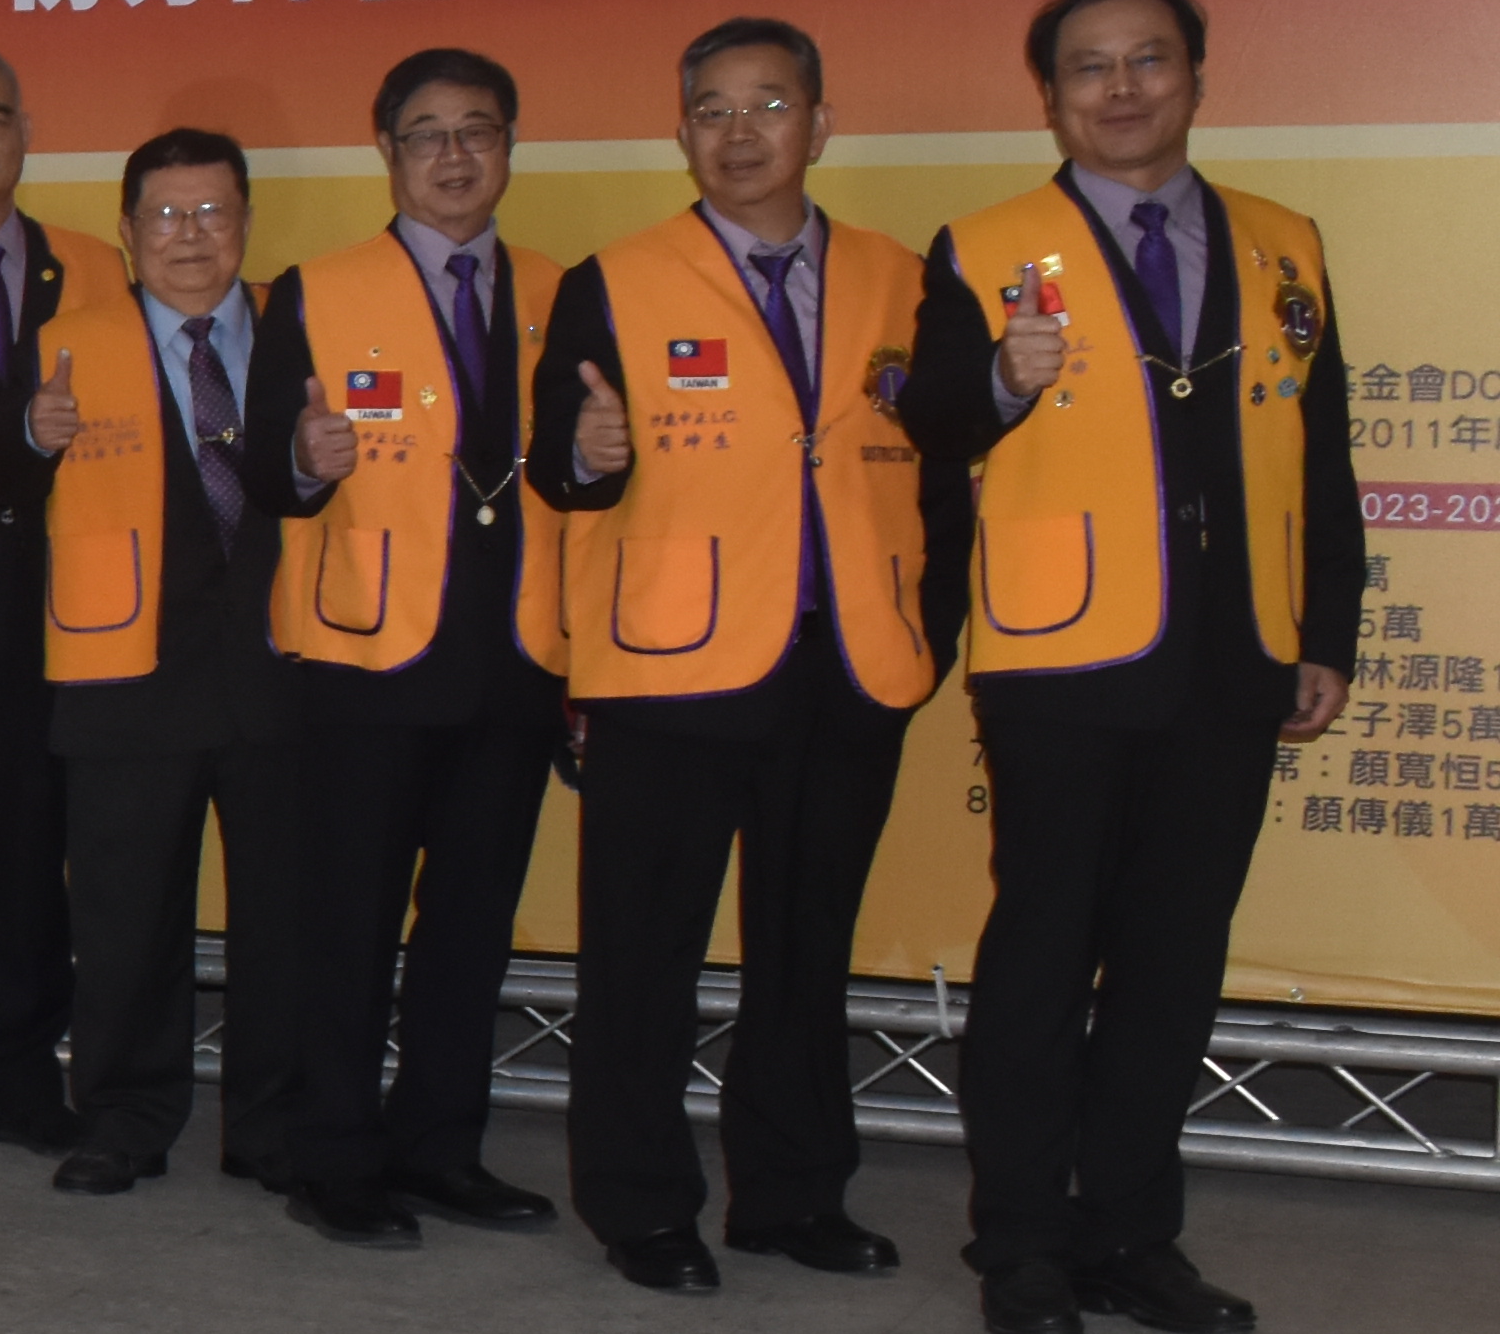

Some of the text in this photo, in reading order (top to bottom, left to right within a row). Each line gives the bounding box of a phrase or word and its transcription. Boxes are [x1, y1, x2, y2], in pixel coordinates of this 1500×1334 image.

[680, 379, 718, 388] TAIWAN
[1349, 414, 1500, 452] 2011年
[1360, 492, 1500, 523] 023-20
[1357, 604, 1424, 643] 5萬
[1323, 701, 1500, 744] 子澤5萬
[966, 785, 987, 814] 8
